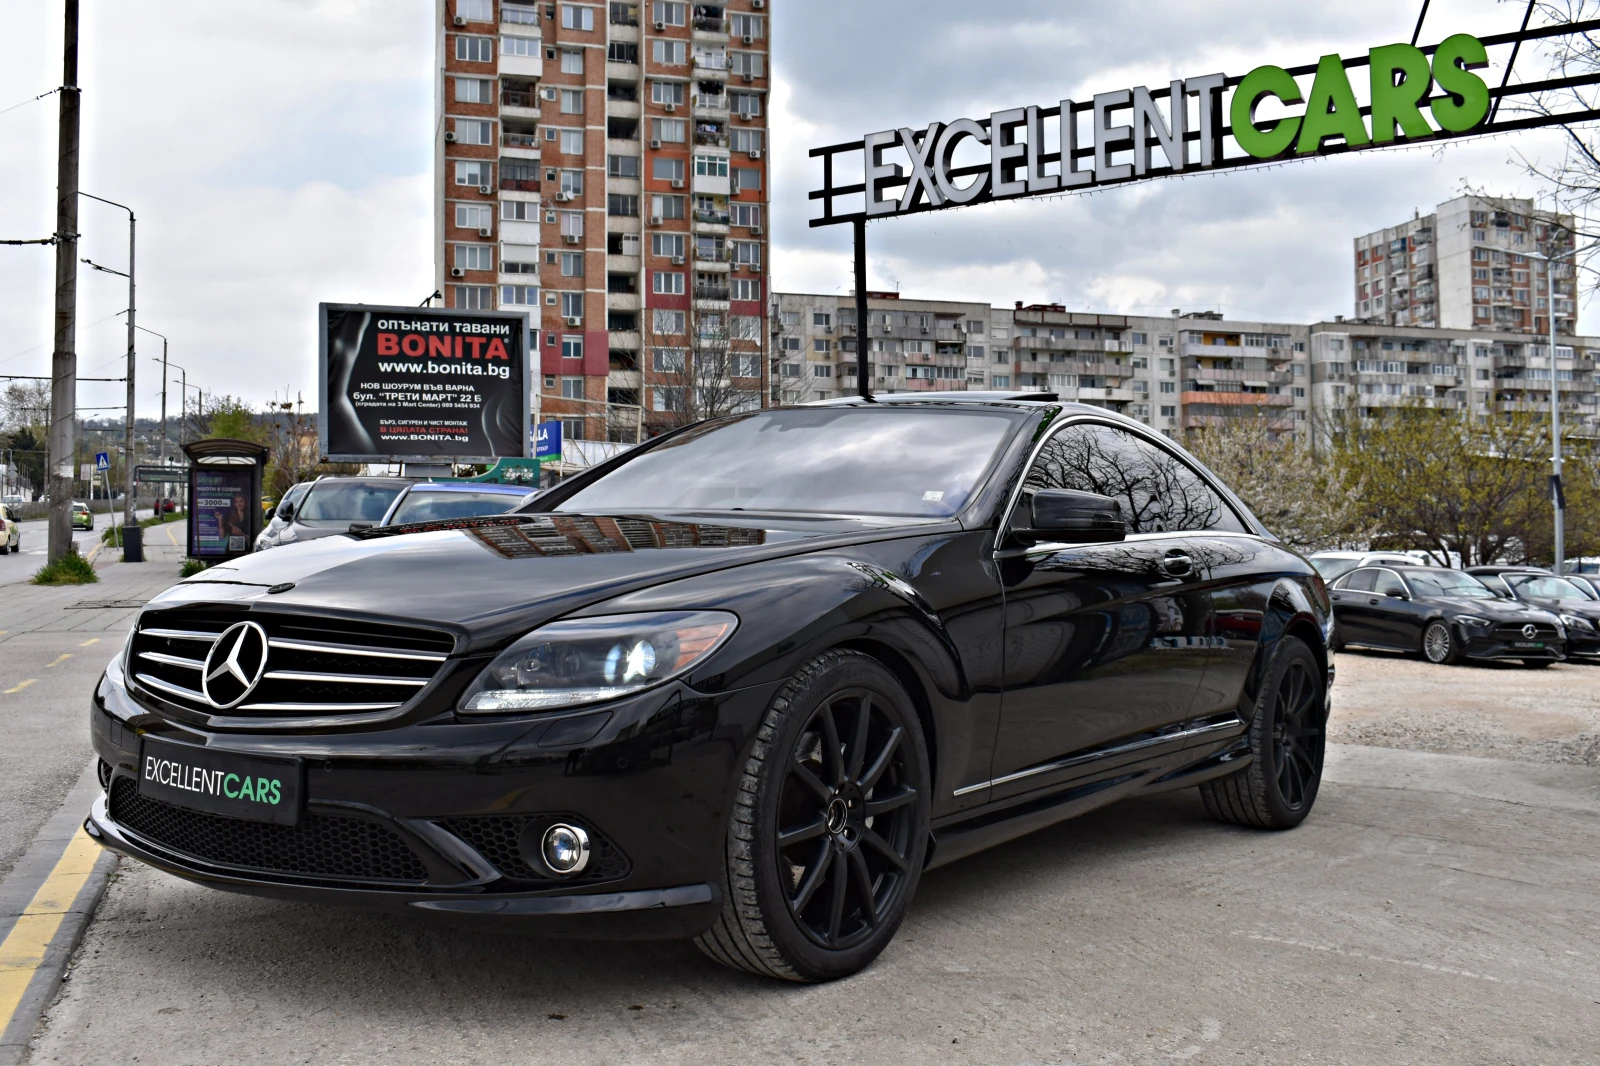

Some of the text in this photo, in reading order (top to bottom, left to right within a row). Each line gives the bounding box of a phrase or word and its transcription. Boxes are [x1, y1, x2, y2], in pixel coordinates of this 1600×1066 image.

[377, 319, 510, 335] опънати тавани
[377, 333, 509, 360] BONITA
[378, 360, 510, 379] www.bonita.bg
[445, 384, 475, 392] ВАРНА
[353, 392, 376, 401] бул.
[460, 394, 472, 402] 22
[474, 394, 482, 402] Б
[381, 434, 469, 442] www.BONITA.bg
